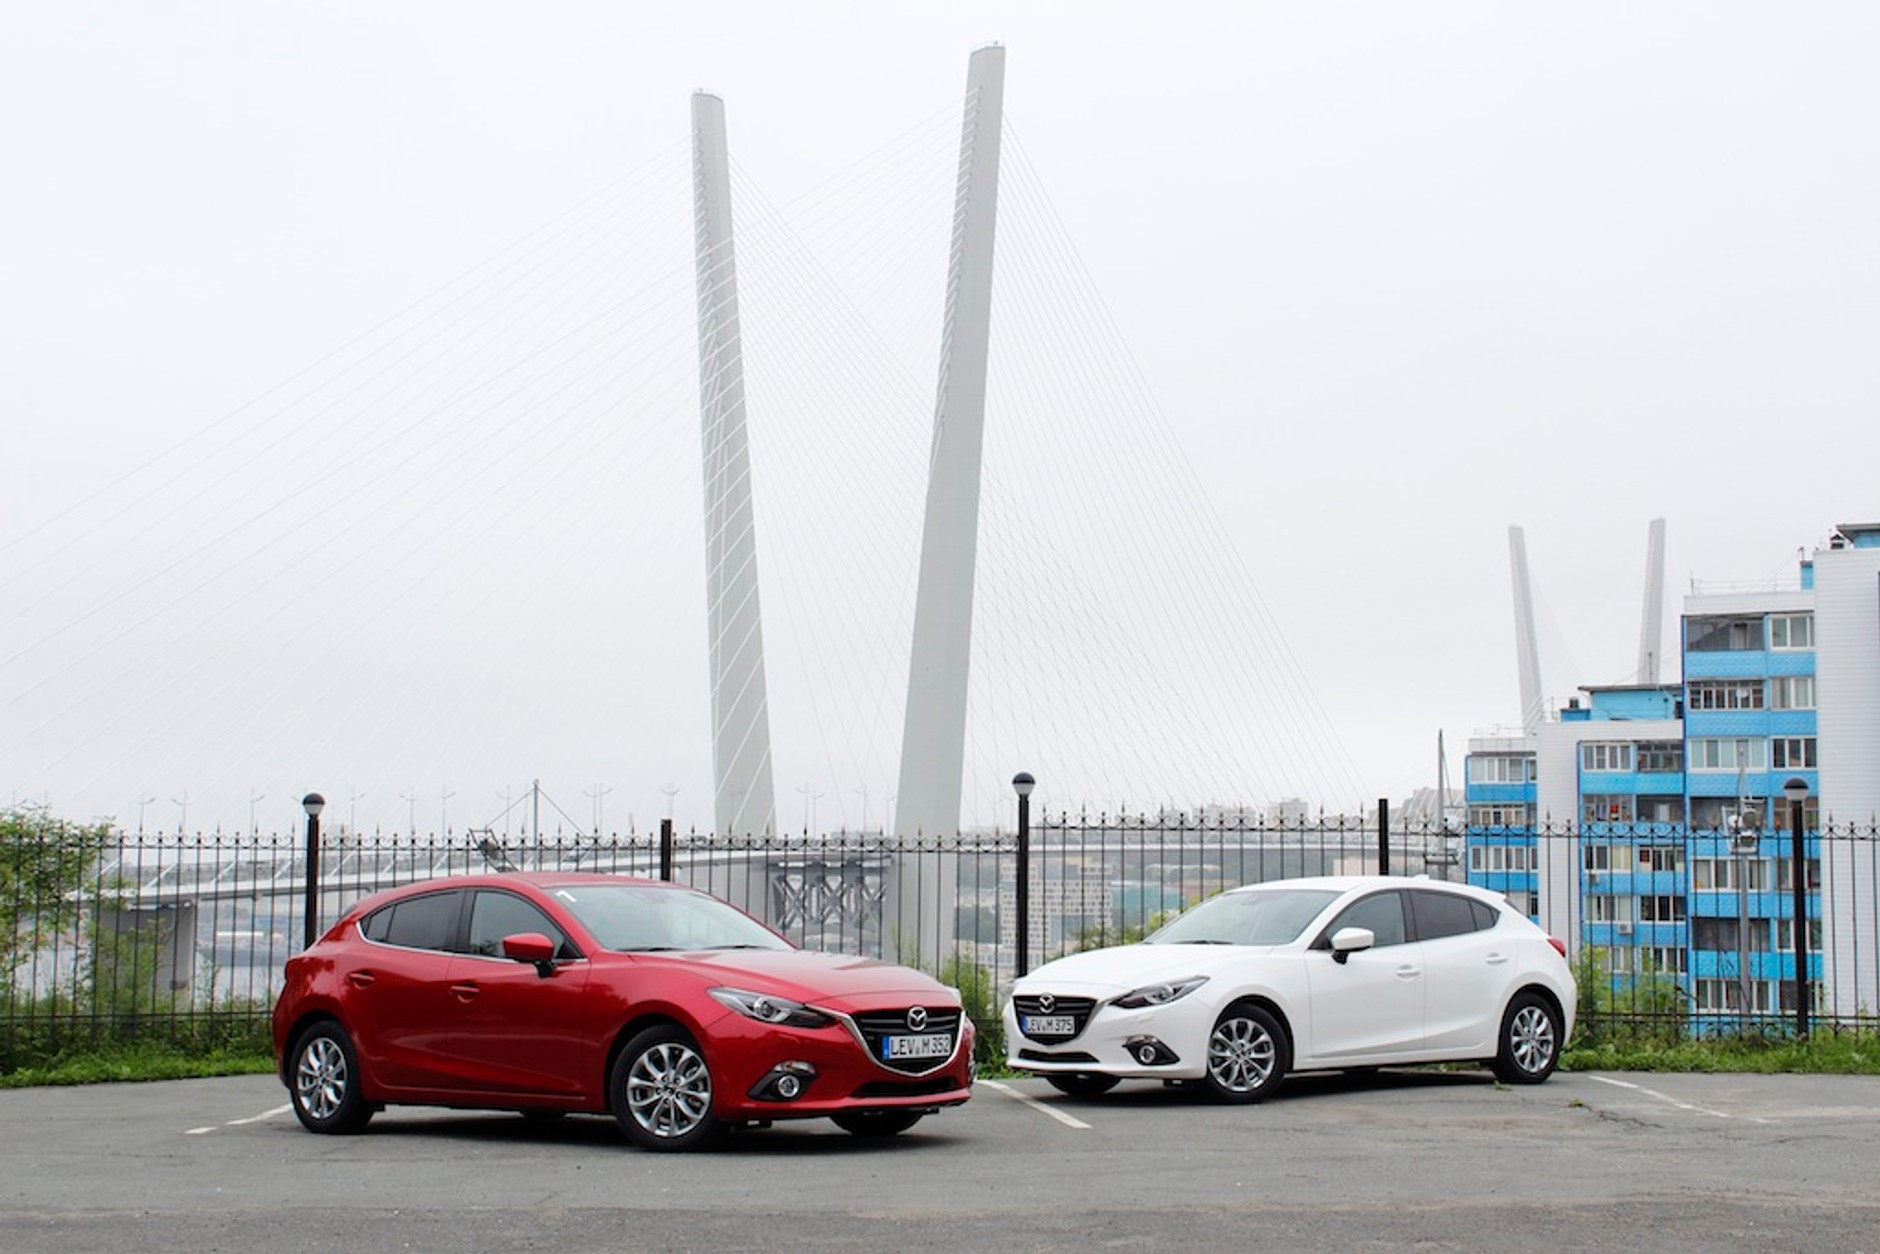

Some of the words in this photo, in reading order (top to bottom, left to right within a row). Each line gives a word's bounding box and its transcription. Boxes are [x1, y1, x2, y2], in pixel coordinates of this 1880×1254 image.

[1027, 1019, 1042, 1032] LEV
[1046, 1019, 1053, 1032] M
[1055, 1018, 1073, 1032] 375
[890, 1038, 915, 1055] LEV
[921, 1037, 930, 1054] M
